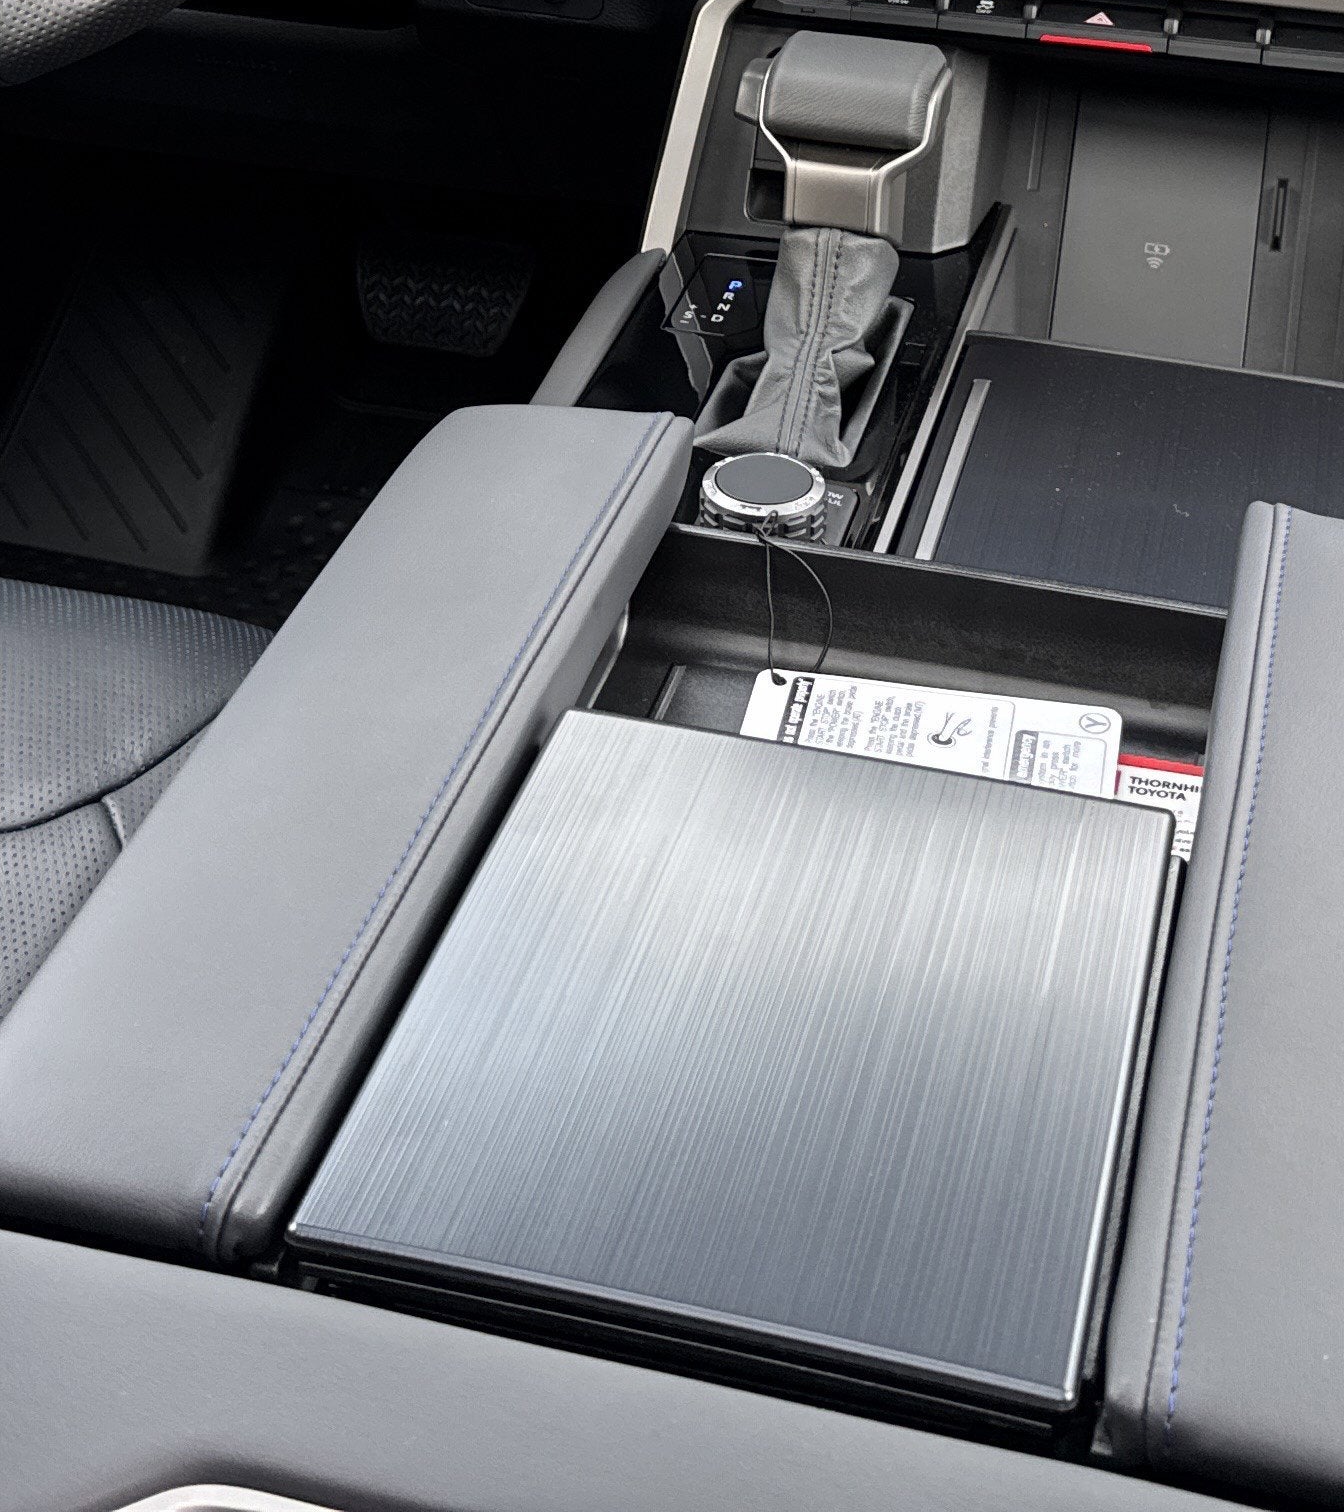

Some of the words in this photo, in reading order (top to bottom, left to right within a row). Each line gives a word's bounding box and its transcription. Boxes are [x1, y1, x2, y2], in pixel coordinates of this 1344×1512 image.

[729, 280, 743, 290] P
[722, 291, 735, 301] R
[716, 302, 731, 312] N
[710, 313, 724, 323] D
[1128, 786, 1186, 801] TOYOTA
